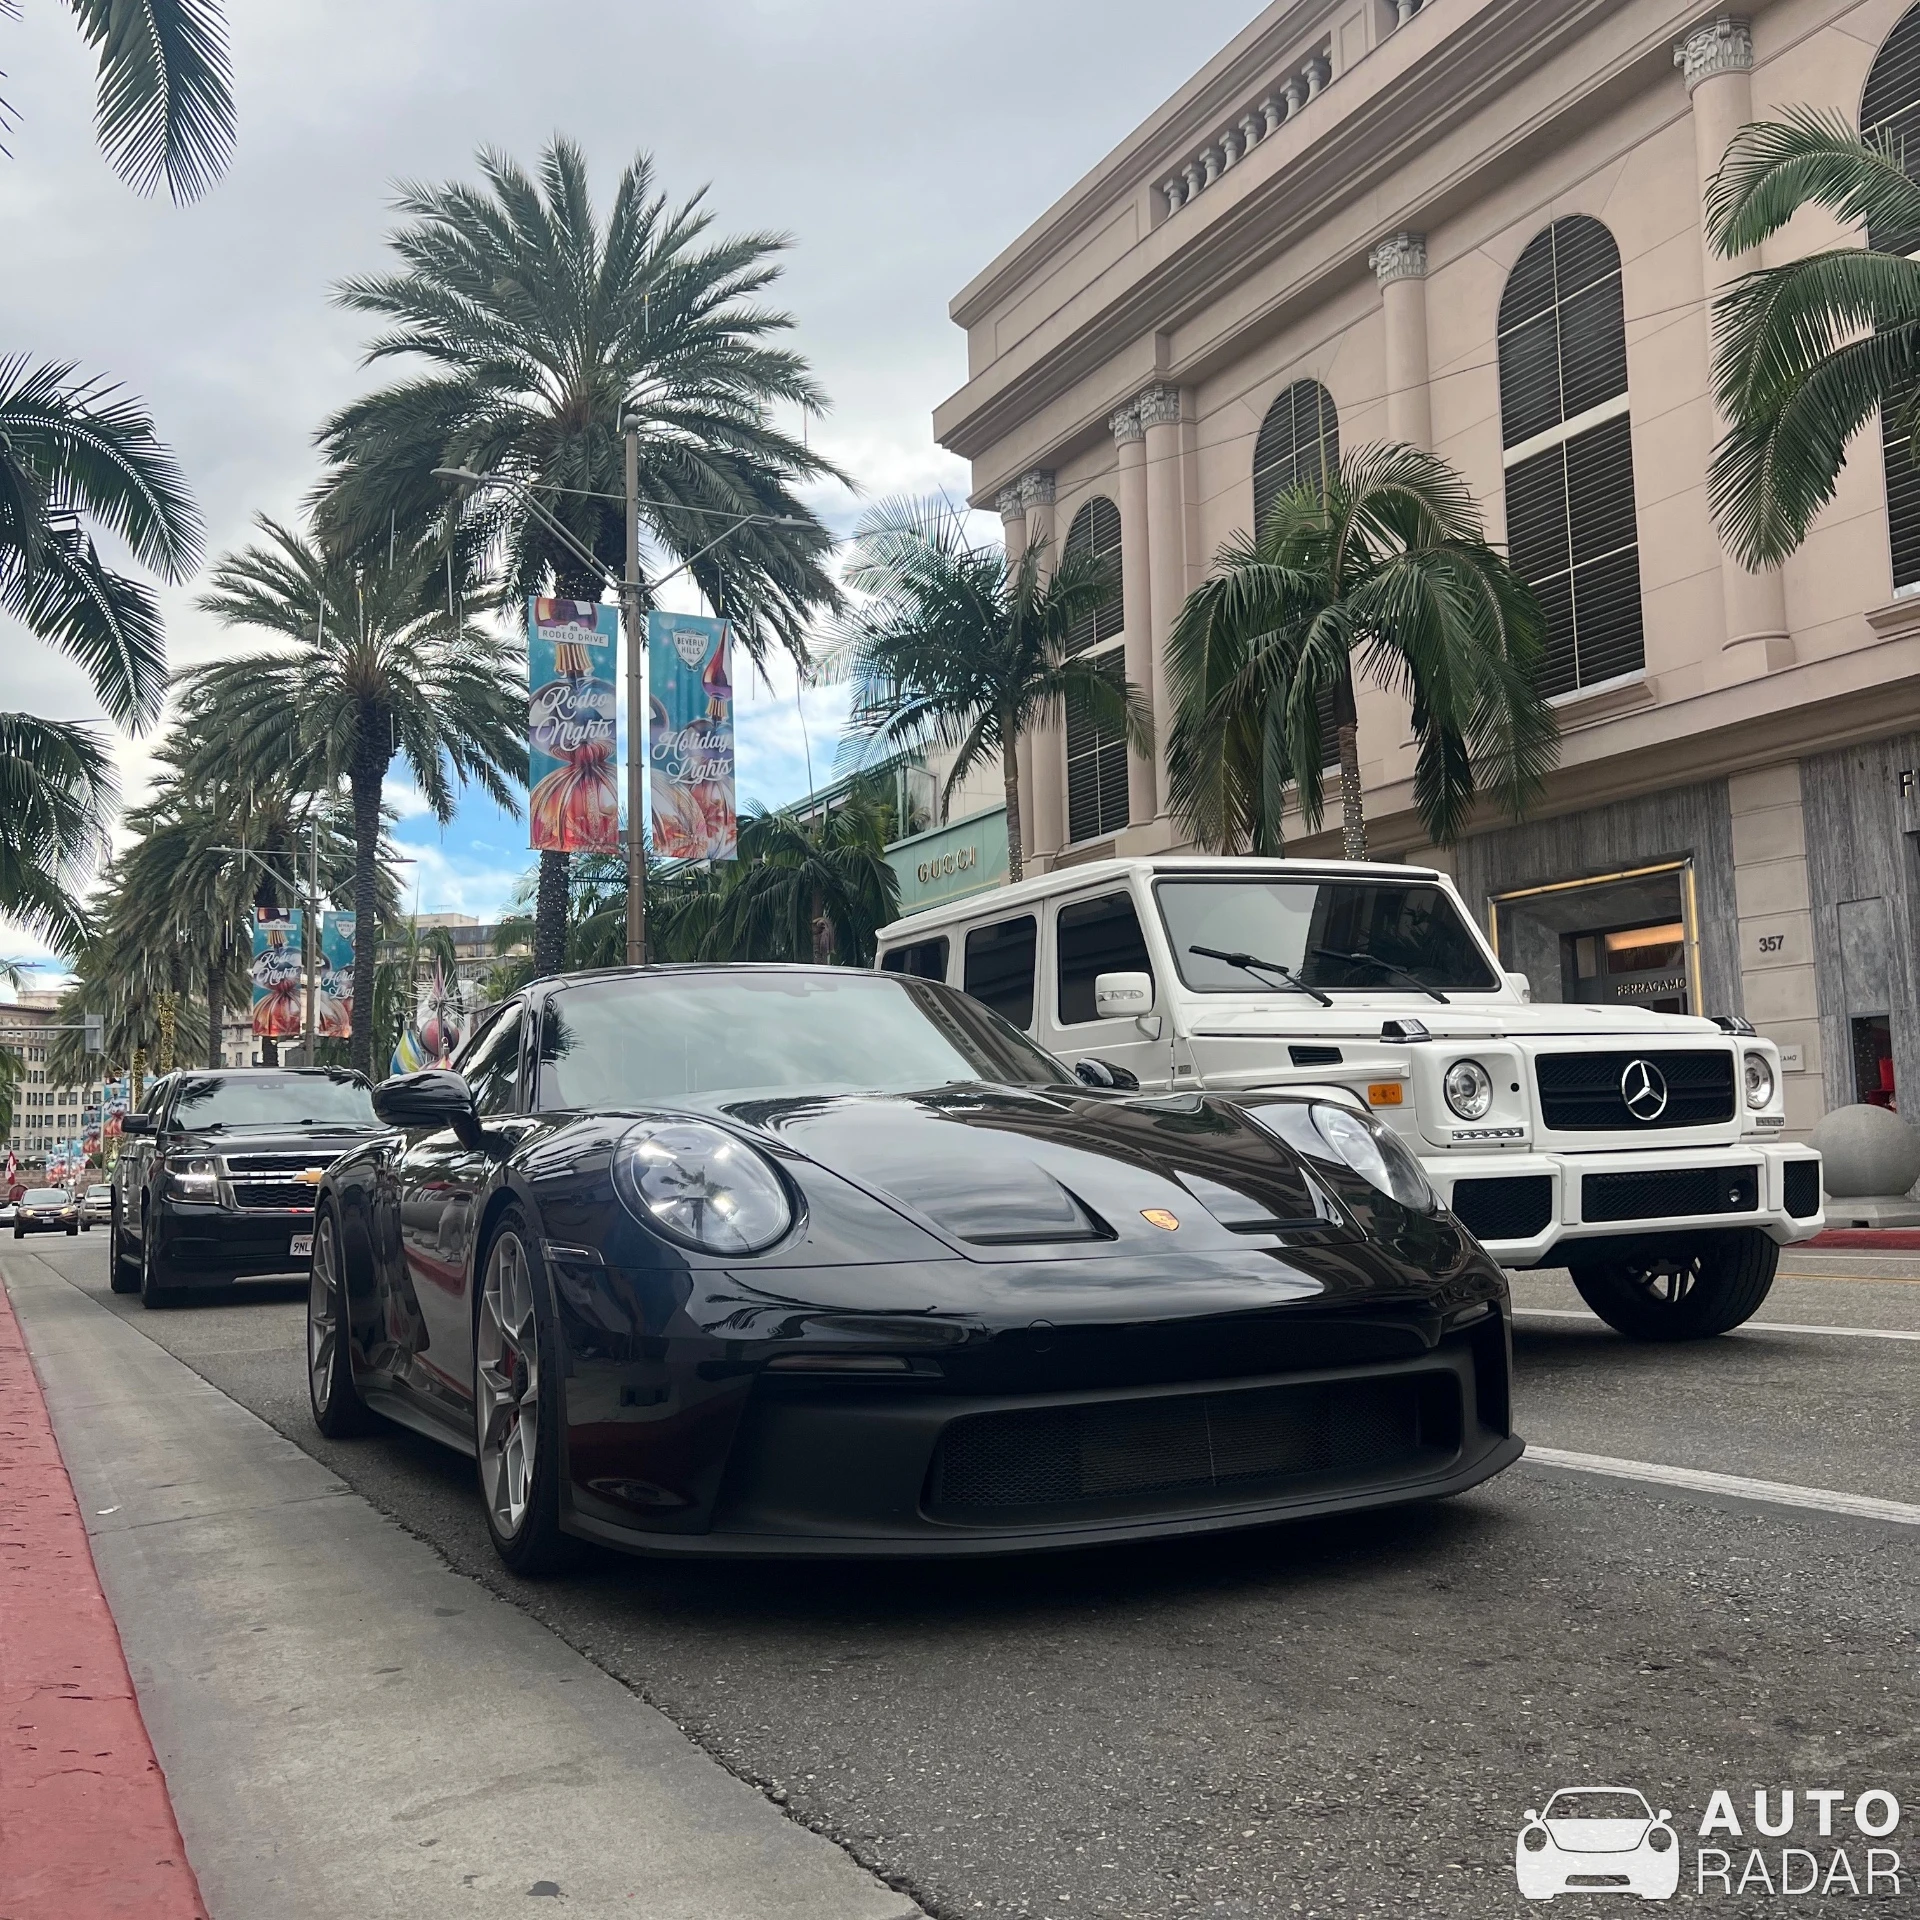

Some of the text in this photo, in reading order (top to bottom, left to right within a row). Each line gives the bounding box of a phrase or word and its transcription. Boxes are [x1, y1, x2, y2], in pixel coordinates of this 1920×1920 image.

[542, 630, 604, 644] RODEO DRIVE
[677, 637, 705, 647] BEVERLY
[681, 646, 701, 655] HILLS
[541, 686, 609, 720] Rodeo
[536, 716, 614, 751] Nights
[651, 729, 730, 760] Holiday
[666, 757, 734, 784] Lights
[1899, 769, 1920, 797] F
[917, 846, 977, 883] GUCCI
[1759, 935, 1784, 953] 357
[257, 967, 298, 986] Nights
[322, 971, 355, 988] Holid
[1617, 977, 1687, 997] FERRAGAMO
